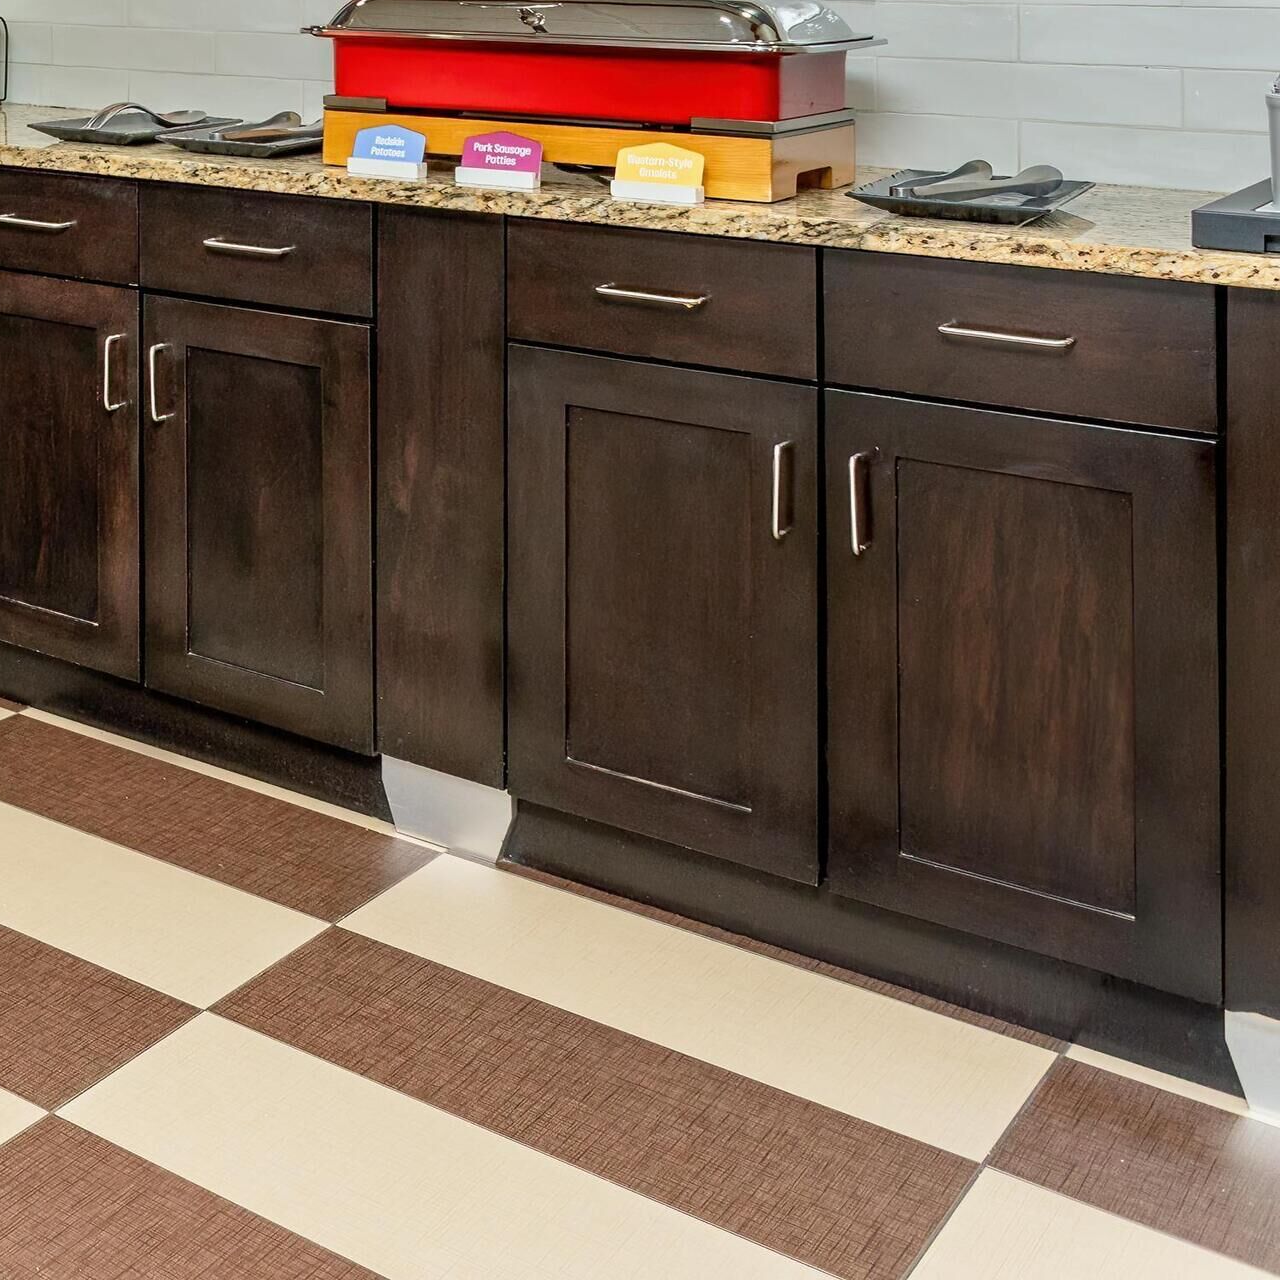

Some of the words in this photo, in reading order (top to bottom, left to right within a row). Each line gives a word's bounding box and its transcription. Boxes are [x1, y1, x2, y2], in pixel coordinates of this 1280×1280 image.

[370, 146, 406, 158] Potatoes
[473, 142, 493, 153] Pork
[493, 144, 532, 157] Sausage
[485, 154, 516, 166] Patties
